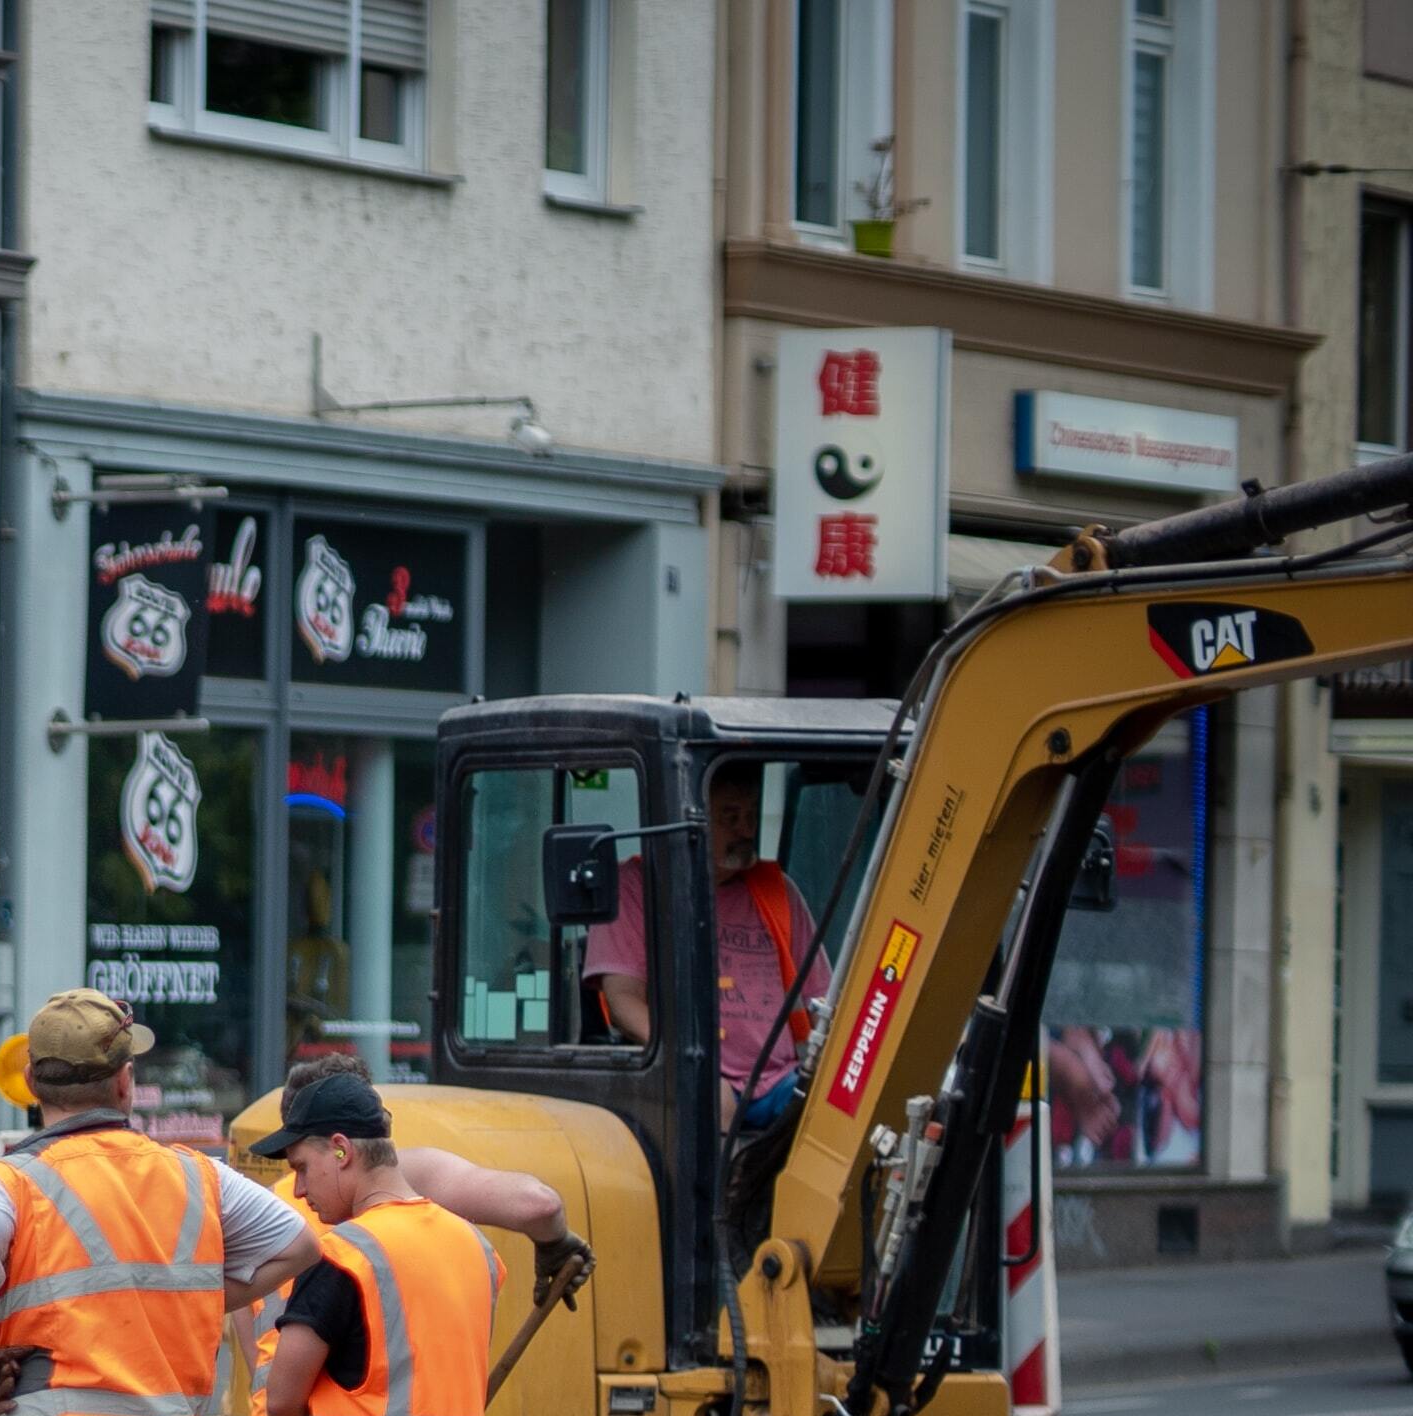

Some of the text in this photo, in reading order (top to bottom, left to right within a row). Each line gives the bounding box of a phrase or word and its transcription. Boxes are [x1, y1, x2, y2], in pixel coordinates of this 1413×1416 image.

[1190, 609, 1258, 672] CAT
[909, 861, 931, 903] hier
[88, 952, 220, 1003] GEÖFFNET
[841, 990, 888, 1094] ZEPPELIN
